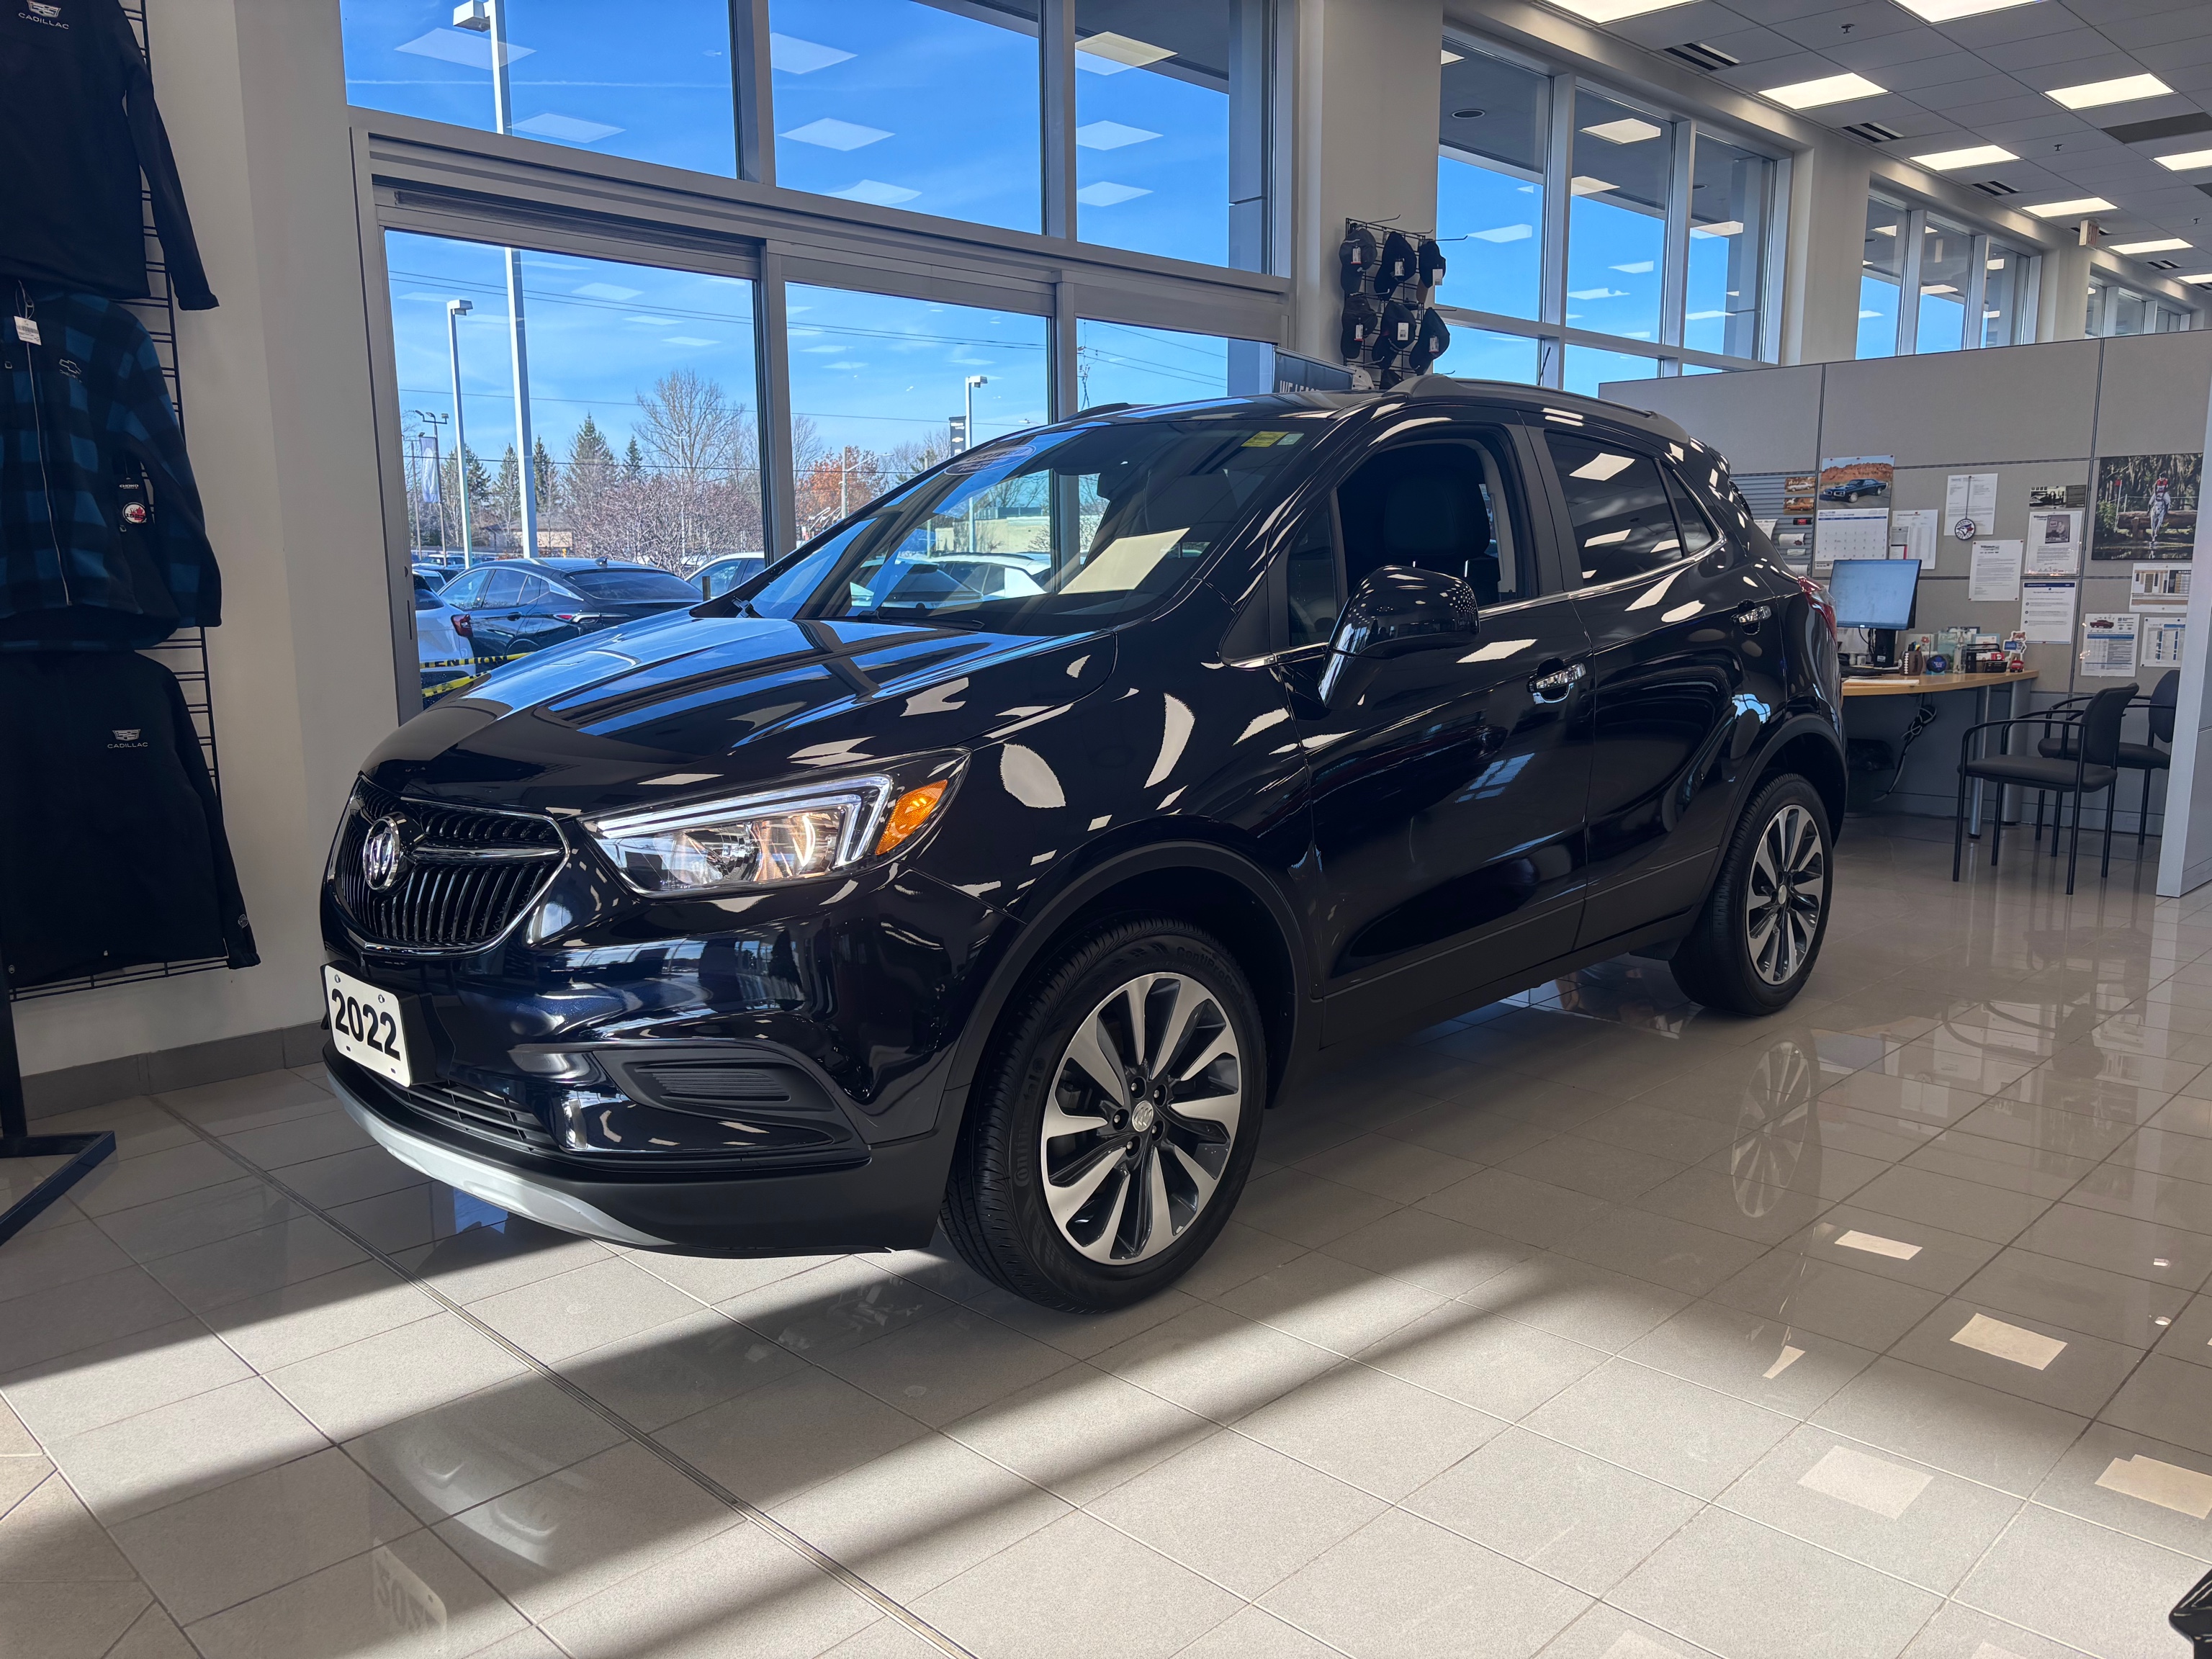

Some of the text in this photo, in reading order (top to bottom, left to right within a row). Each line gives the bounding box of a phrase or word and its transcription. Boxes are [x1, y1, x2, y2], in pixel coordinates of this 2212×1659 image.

[18, 12, 69, 30] CADILLAC
[1280, 380, 1321, 393] WE LEA
[331, 988, 401, 1061] 2022
